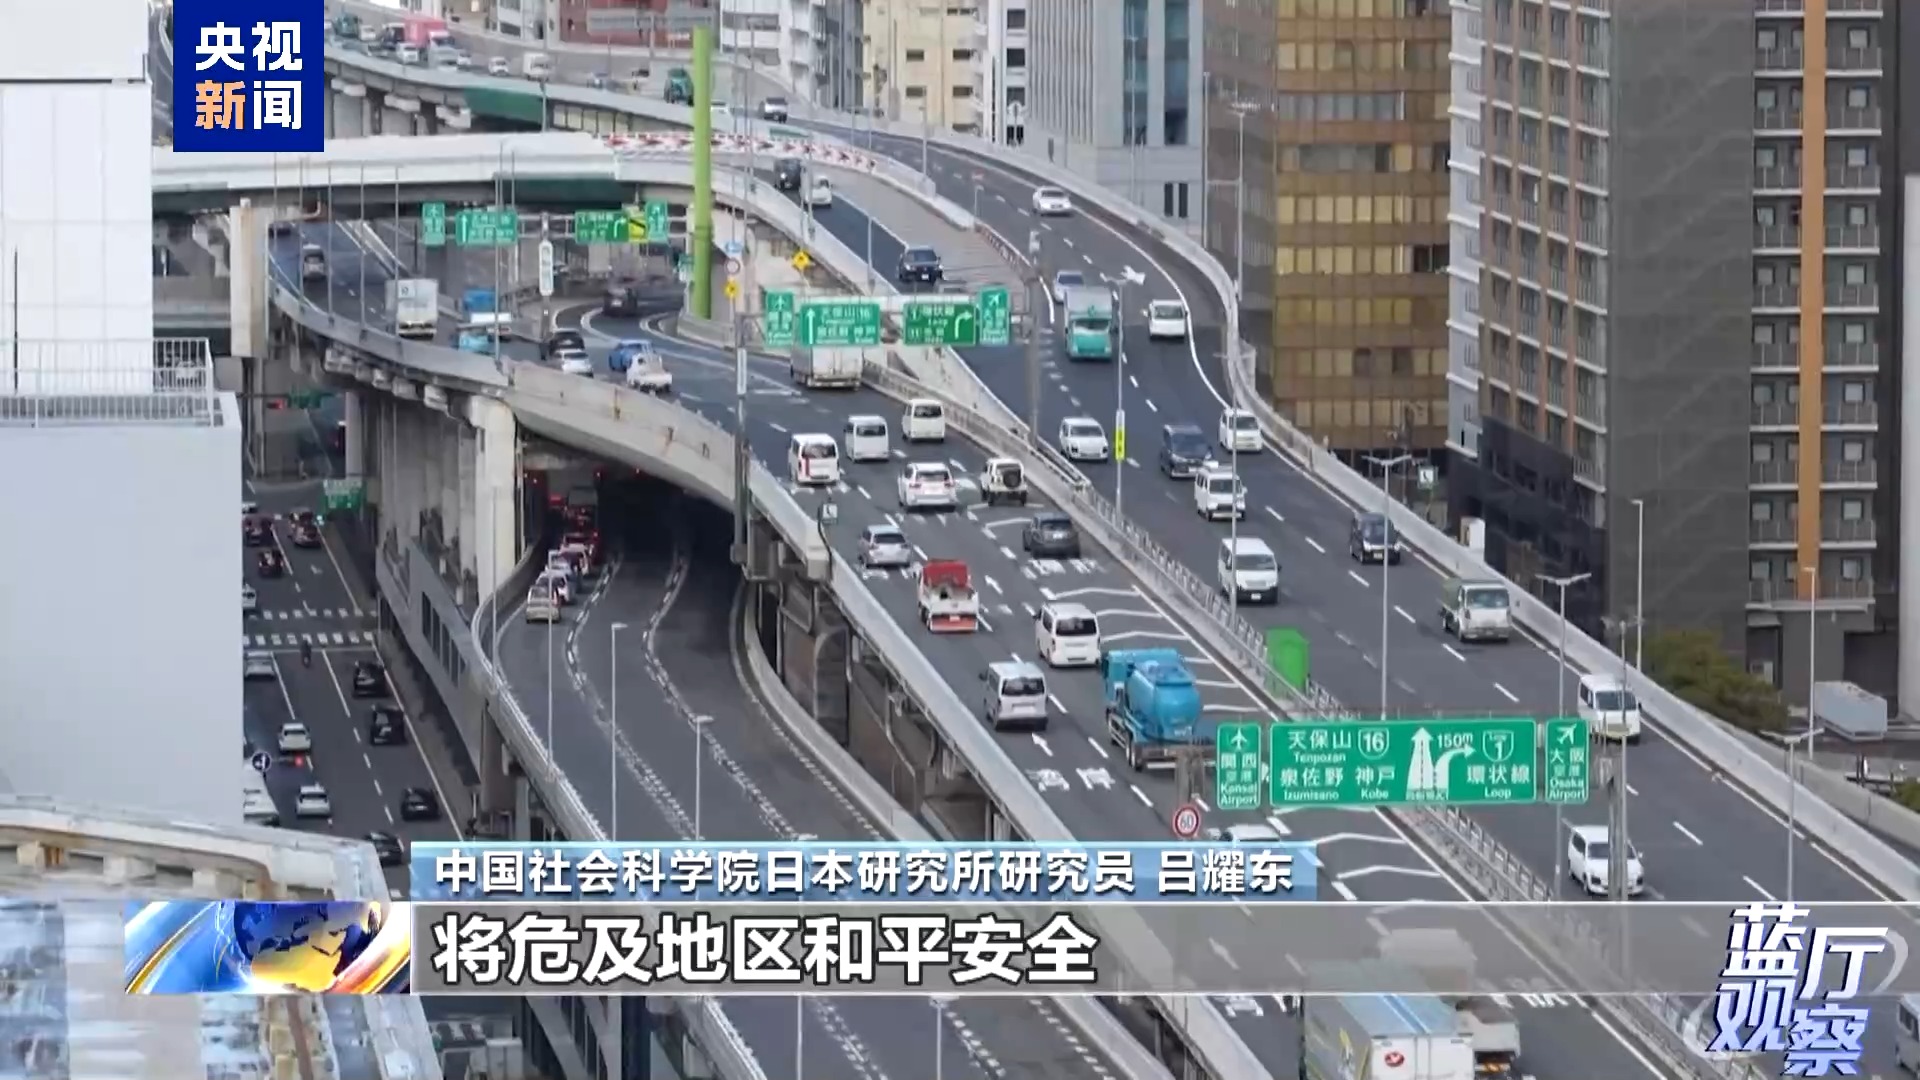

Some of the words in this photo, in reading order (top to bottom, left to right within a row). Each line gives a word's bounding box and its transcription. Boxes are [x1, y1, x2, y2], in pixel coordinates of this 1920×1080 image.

[1288, 729, 1352, 750] 天保山
[1362, 732, 1385, 752] 16
[1437, 732, 1474, 748] 150m
[1294, 751, 1346, 764] Tenpozan
[1355, 766, 1395, 785] 神戸
[1549, 777, 1585, 788] Osaka
[1284, 790, 1340, 801] Izumisano
[1360, 788, 1389, 800] Kobe
[1484, 787, 1512, 799] Loop
[1549, 788, 1586, 801] Airport
[1220, 794, 1258, 807] Airport
